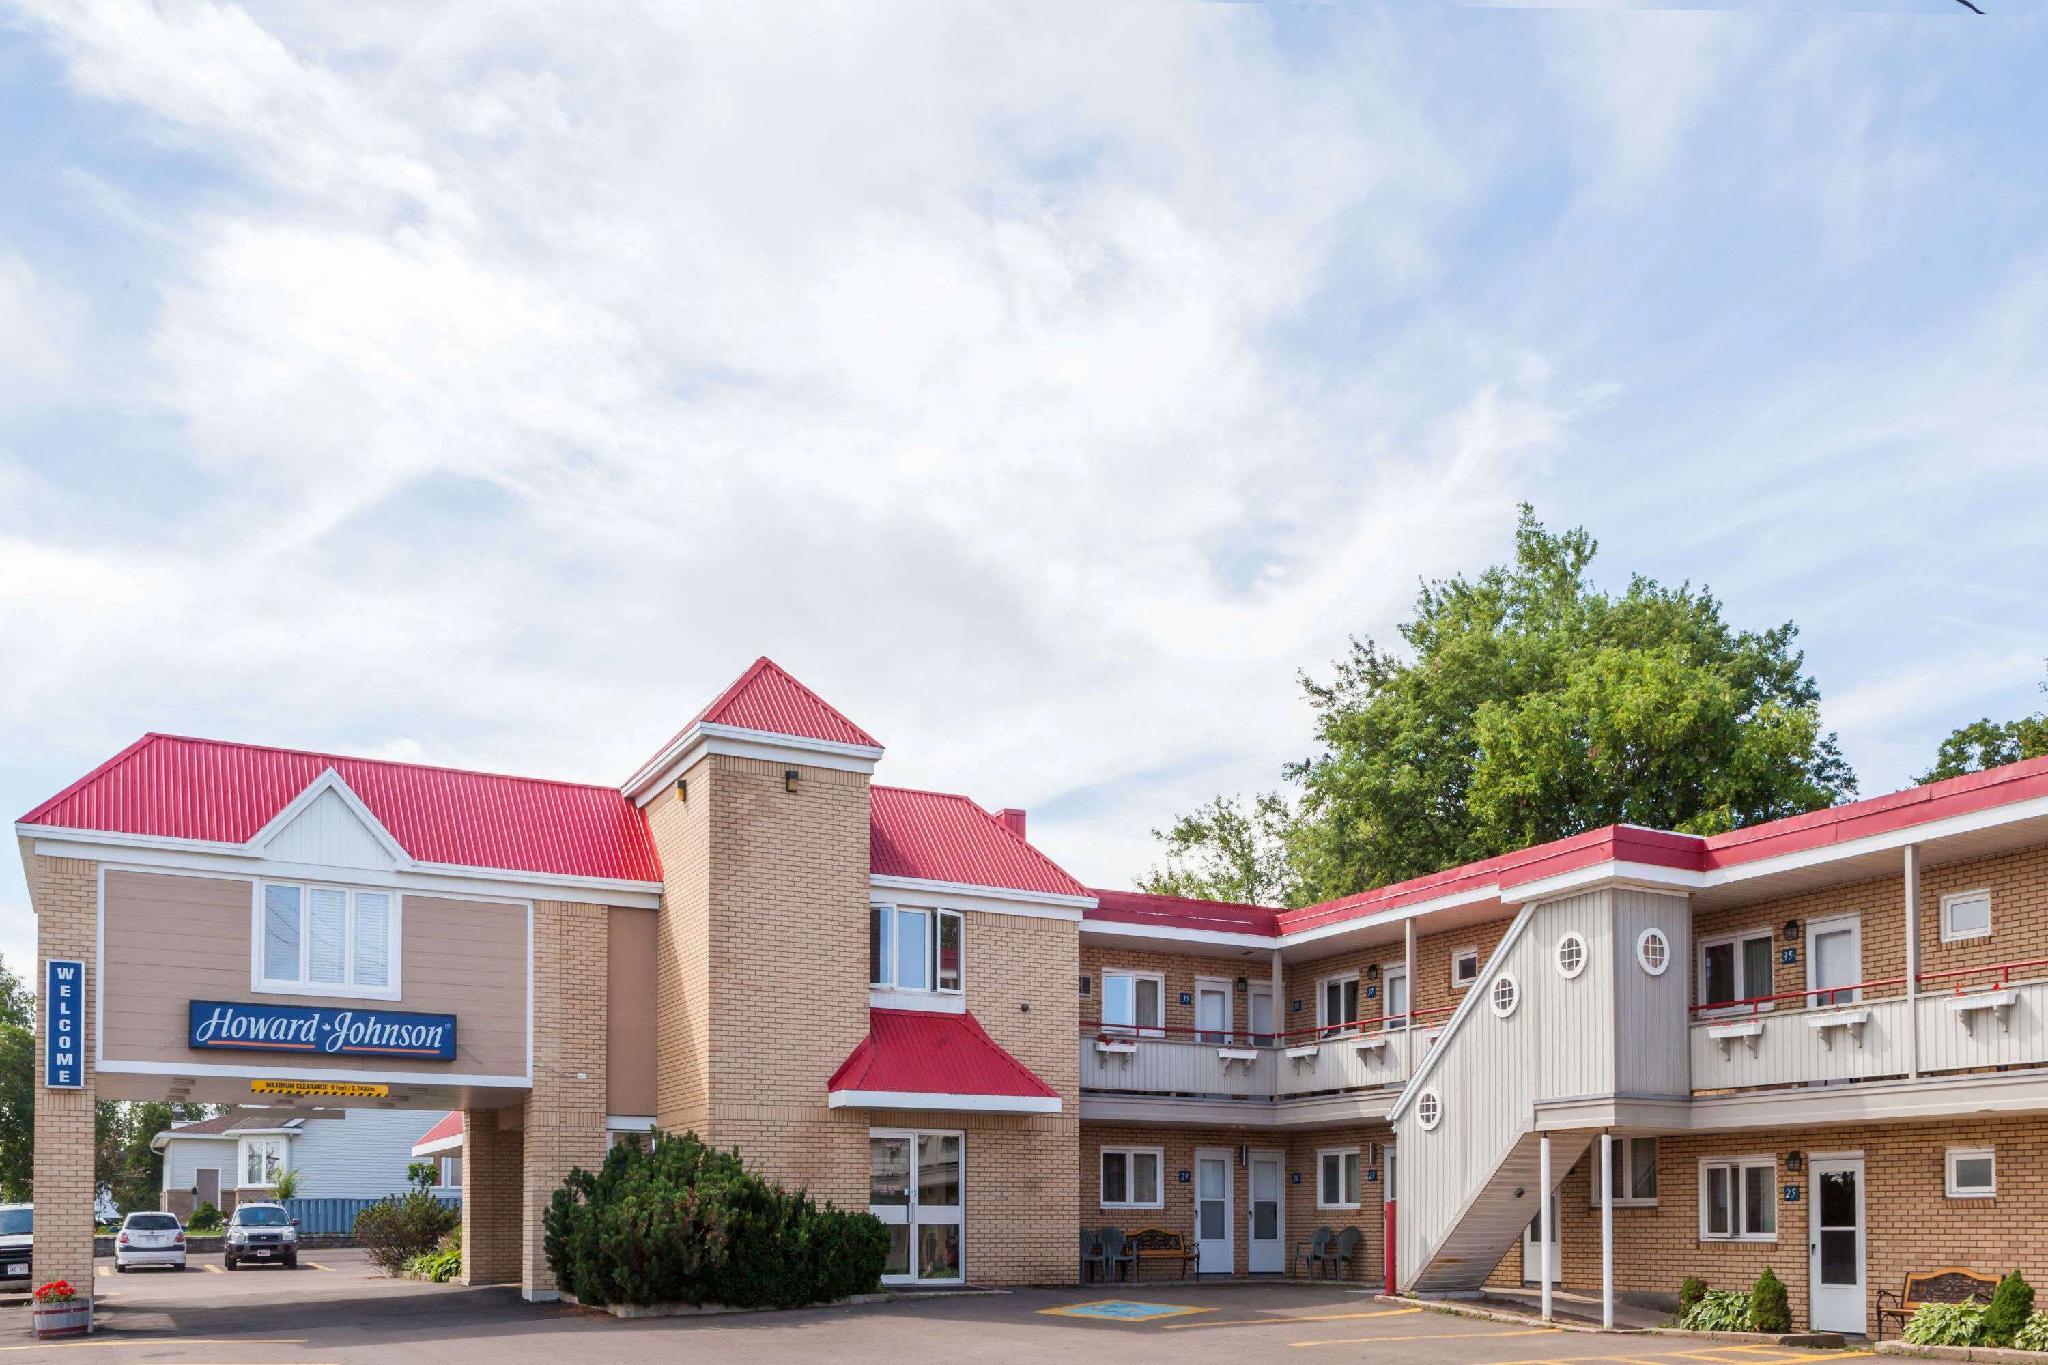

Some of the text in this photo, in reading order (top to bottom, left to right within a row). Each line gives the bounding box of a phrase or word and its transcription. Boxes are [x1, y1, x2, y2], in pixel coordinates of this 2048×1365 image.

[56, 967, 75, 1083] WELCOME
[196, 1008, 443, 1053] Howard Johnson
[1785, 1188, 1797, 1200] 25
